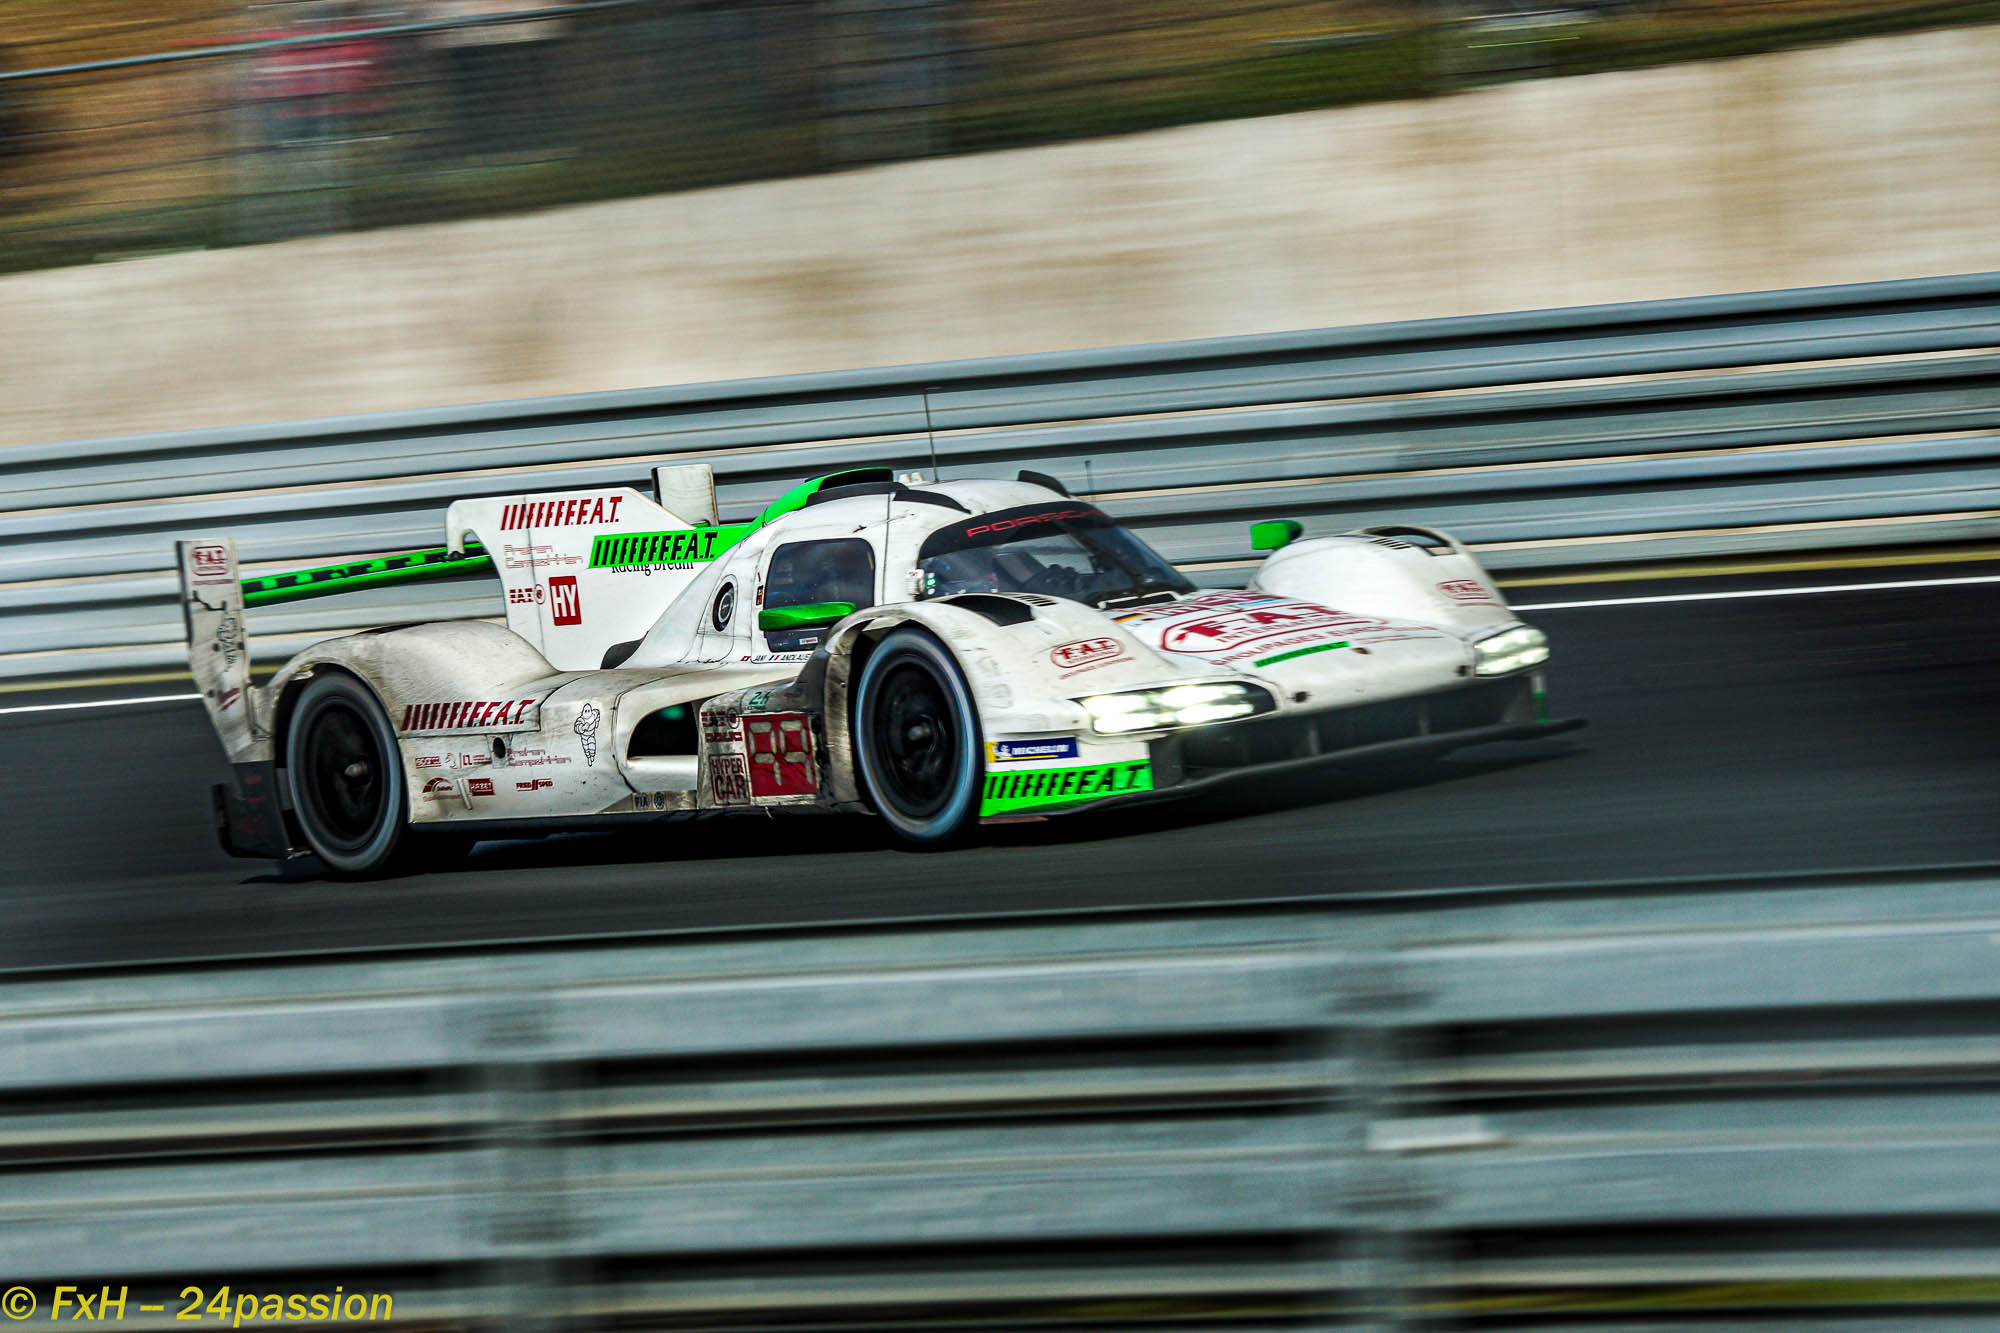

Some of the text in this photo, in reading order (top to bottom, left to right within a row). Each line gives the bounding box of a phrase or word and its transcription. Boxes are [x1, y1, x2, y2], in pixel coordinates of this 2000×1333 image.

[551, 584, 577, 618] HY
[749, 720, 814, 787] 99
[1011, 744, 1069, 756] MICHELIN
[711, 758, 744, 775] HYPER
[714, 775, 748, 801] CAR
